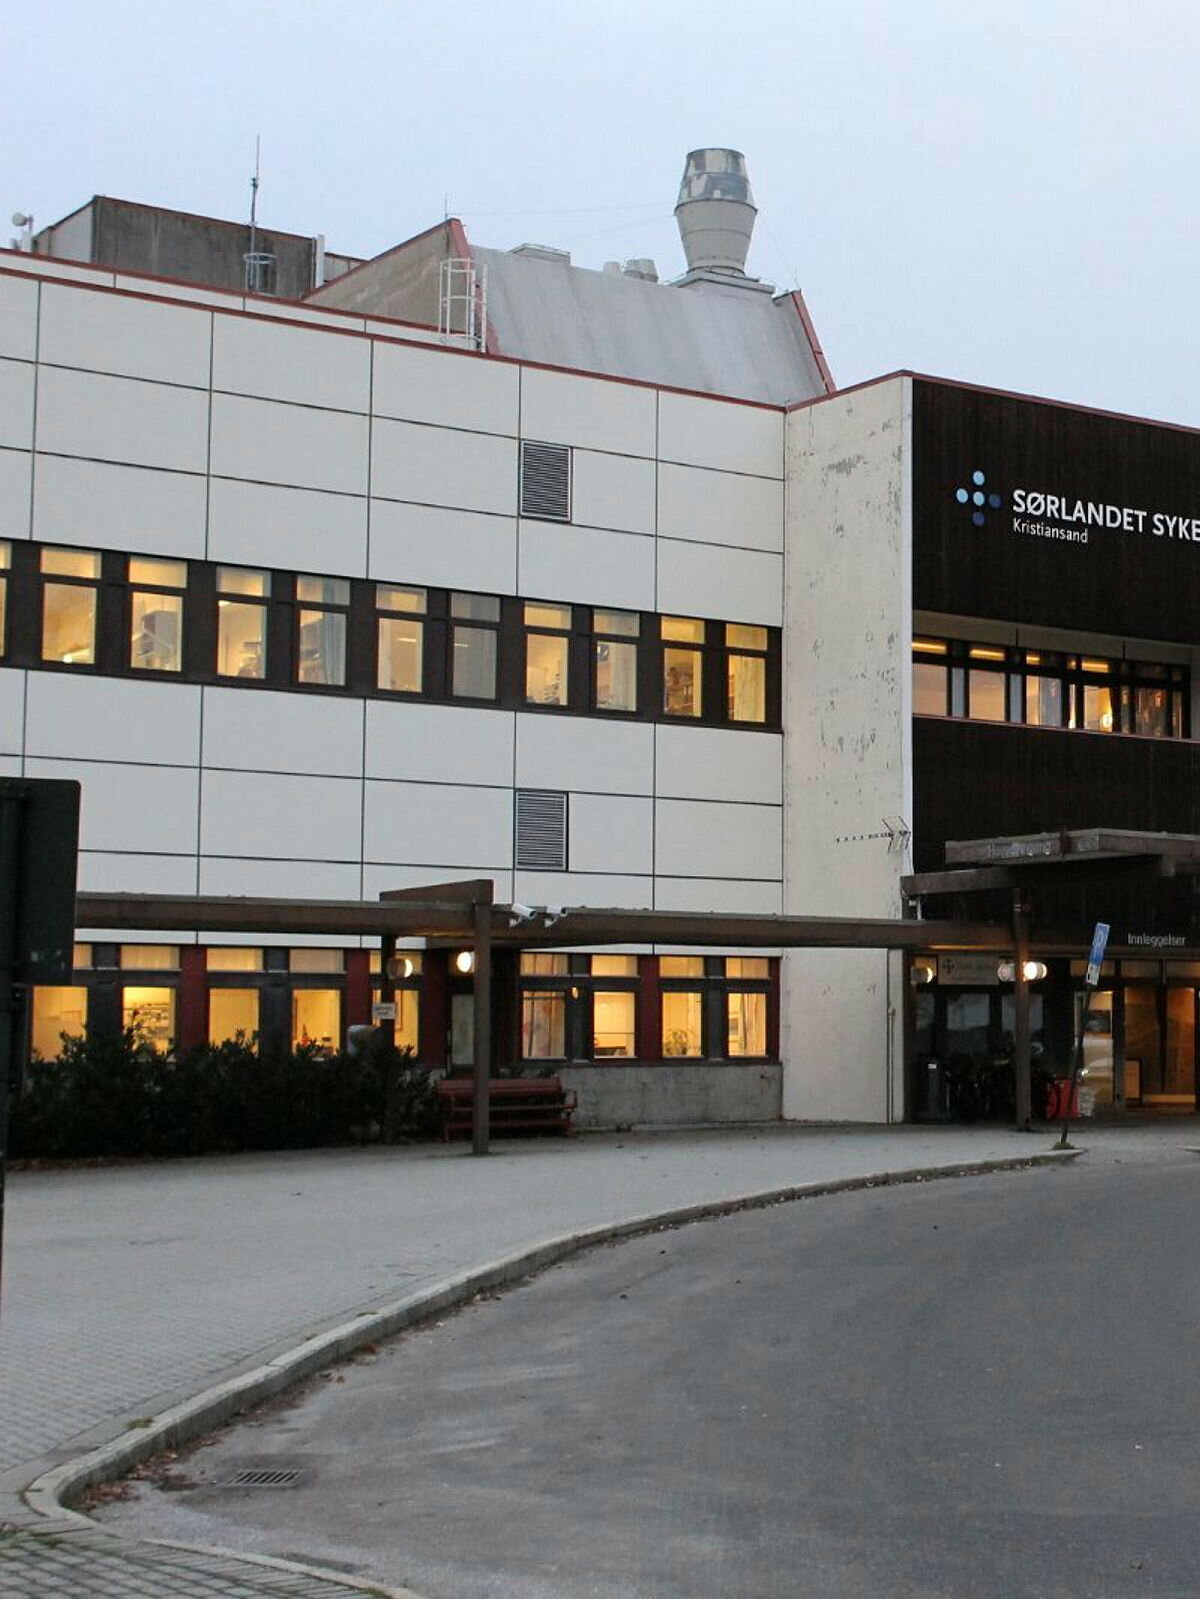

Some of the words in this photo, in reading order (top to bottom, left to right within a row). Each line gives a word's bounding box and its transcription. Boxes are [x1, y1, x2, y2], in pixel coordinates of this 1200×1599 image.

[1012, 489, 1147, 532] SØRLANDET
[1012, 518, 1089, 543] Kristiansand
[1127, 932, 1186, 948] Innleggelser
